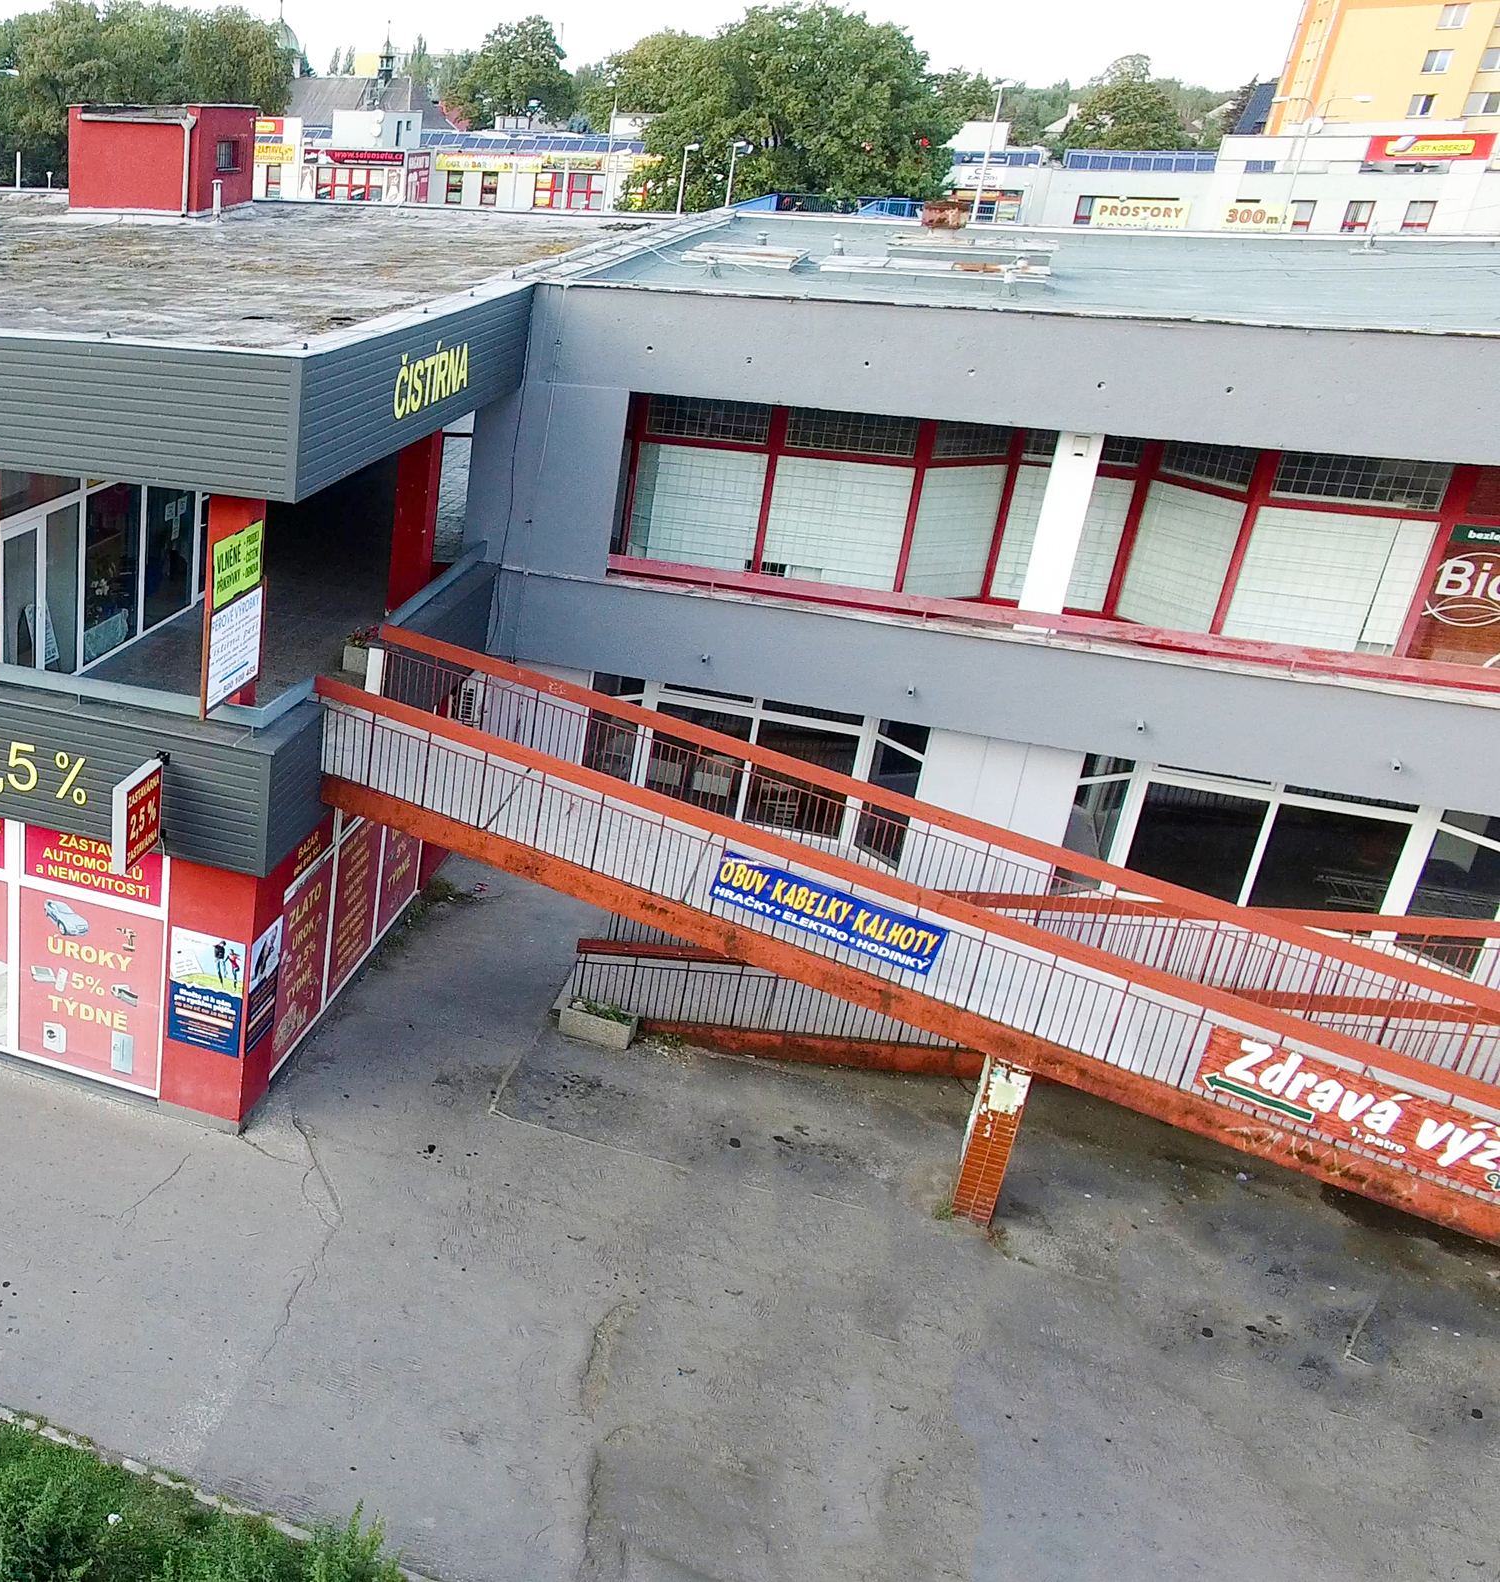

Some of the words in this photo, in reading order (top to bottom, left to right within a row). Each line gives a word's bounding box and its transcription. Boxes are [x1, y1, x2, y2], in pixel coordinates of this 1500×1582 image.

[1099, 204, 1184, 219] PROSTORY
[1225, 208, 1266, 224] 300
[394, 340, 468, 420] ČISTÍRNA
[54, 750, 88, 806] %
[128, 774, 160, 809] ZASTAVÁRNA
[130, 805, 145, 840] 2,5
[298, 831, 319, 860] BAZAR
[36, 863, 44, 874] a
[47, 864, 150, 899] NEMOVITOSTÍ
[288, 881, 322, 932] ZLATO
[719, 861, 771, 894] OBUV
[770, 878, 853, 924] KABELKY
[852, 908, 940, 956] KALHOTY
[713, 886, 776, 914] HRAČKY
[782, 909, 848, 942] ELEKTRO
[855, 938, 931, 970] HODINKY
[47, 934, 133, 973] ÚROKY
[71, 972, 106, 996] 5%
[47, 994, 128, 1031] TÝDNĚ
[1224, 1039, 1412, 1134] Zdravá
[1350, 1126, 1362, 1139] 1.
[1364, 1133, 1407, 1154] patro
